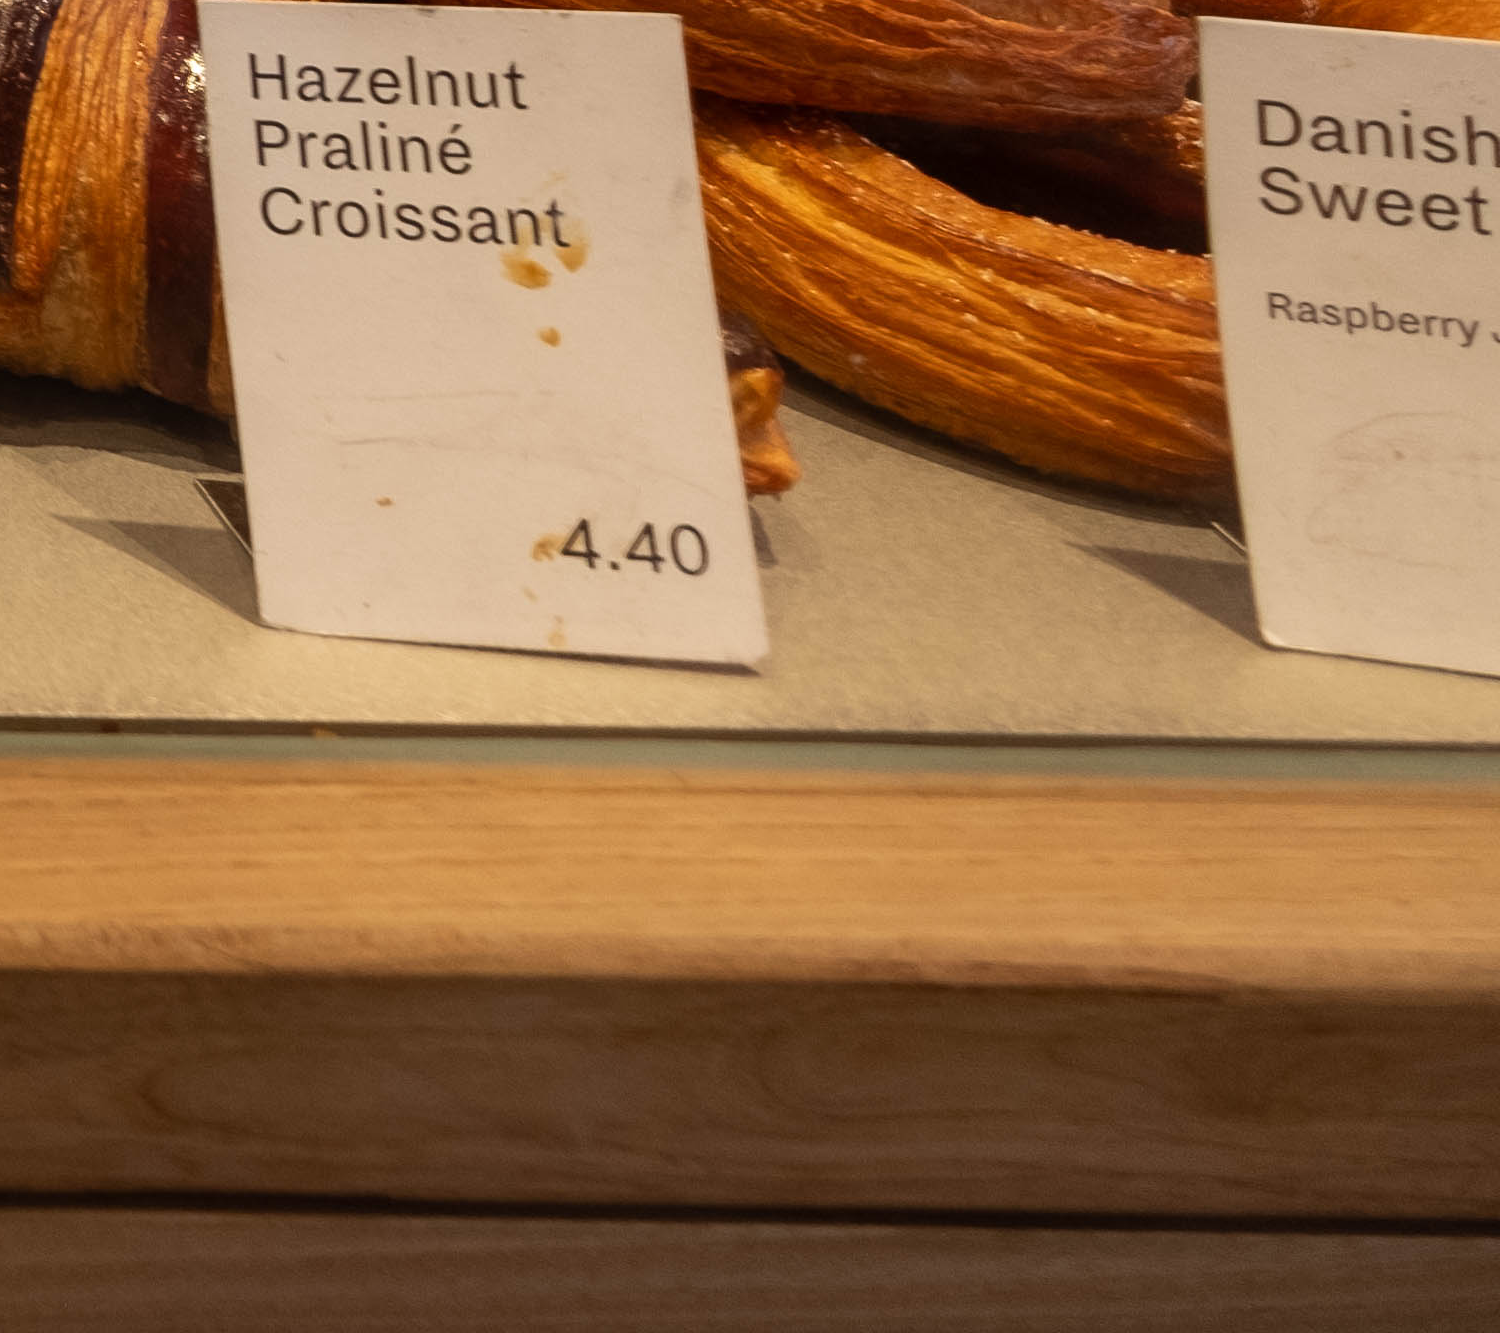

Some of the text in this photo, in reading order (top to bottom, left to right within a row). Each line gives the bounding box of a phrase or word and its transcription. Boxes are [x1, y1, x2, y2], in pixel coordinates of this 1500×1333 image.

[248, 52, 528, 111] Hazelnut
[254, 119, 472, 176] Praliné
[1256, 99, 1500, 172] Danish
[260, 186, 572, 249] Croissant
[1259, 166, 1492, 236] Sweet
[1267, 291, 1480, 348] Raspberry
[559, 518, 709, 577] 4.40
